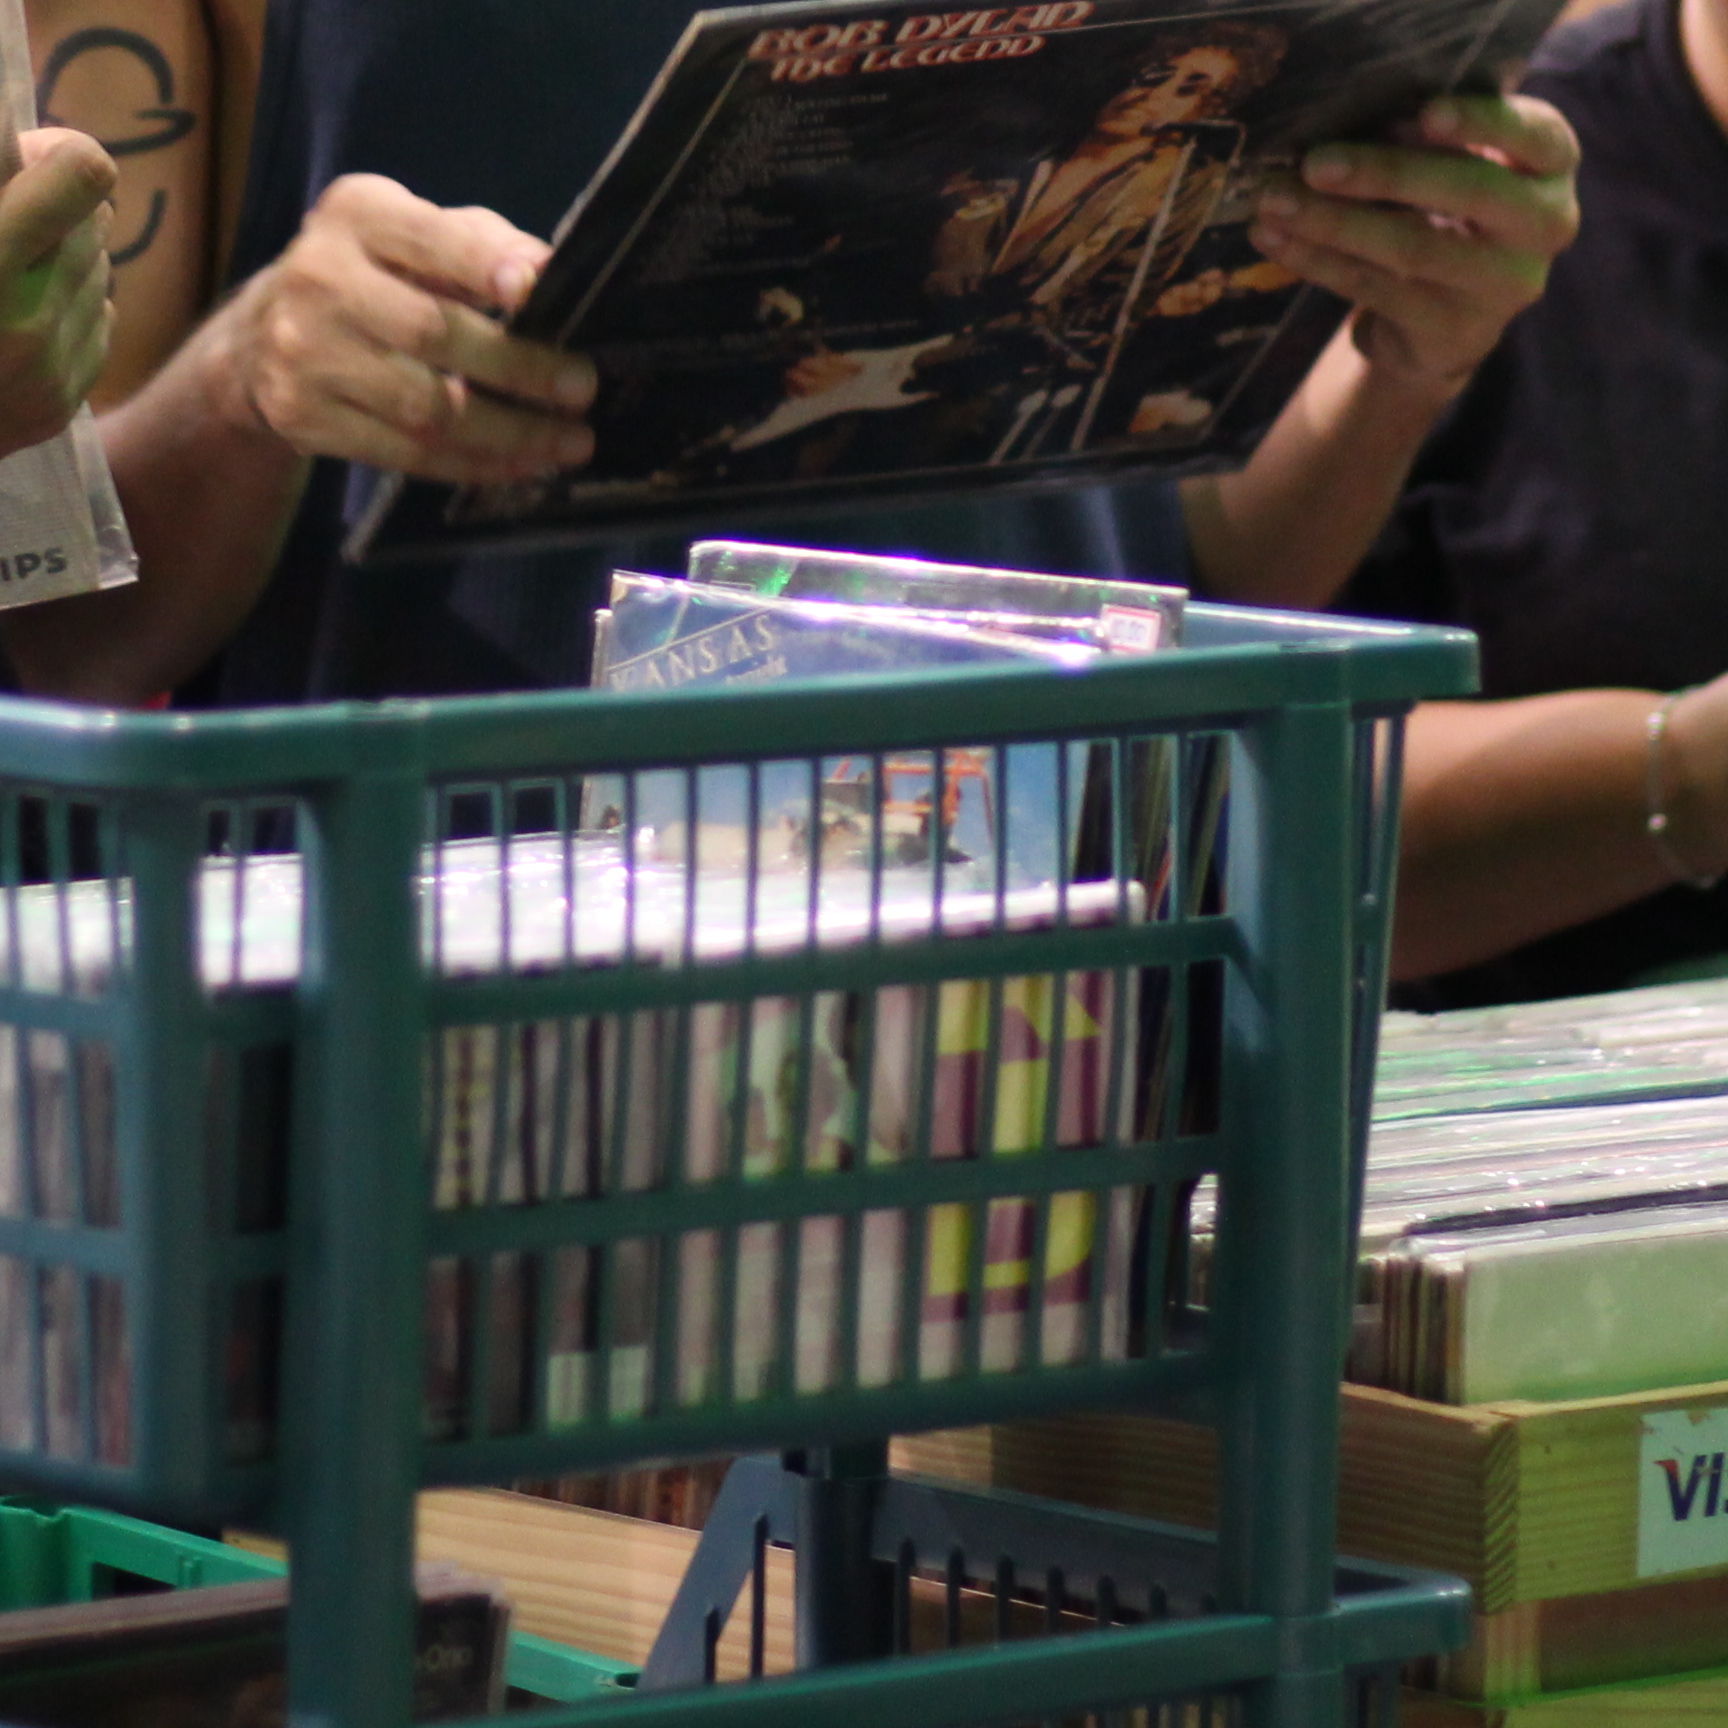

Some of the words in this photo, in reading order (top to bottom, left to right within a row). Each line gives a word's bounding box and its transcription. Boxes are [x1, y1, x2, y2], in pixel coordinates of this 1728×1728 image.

[747, 20, 889, 60] BOB
[894, 0, 1096, 46] DYLAN
[770, 54, 860, 84] THE
[860, 35, 1046, 73] LEGEND
